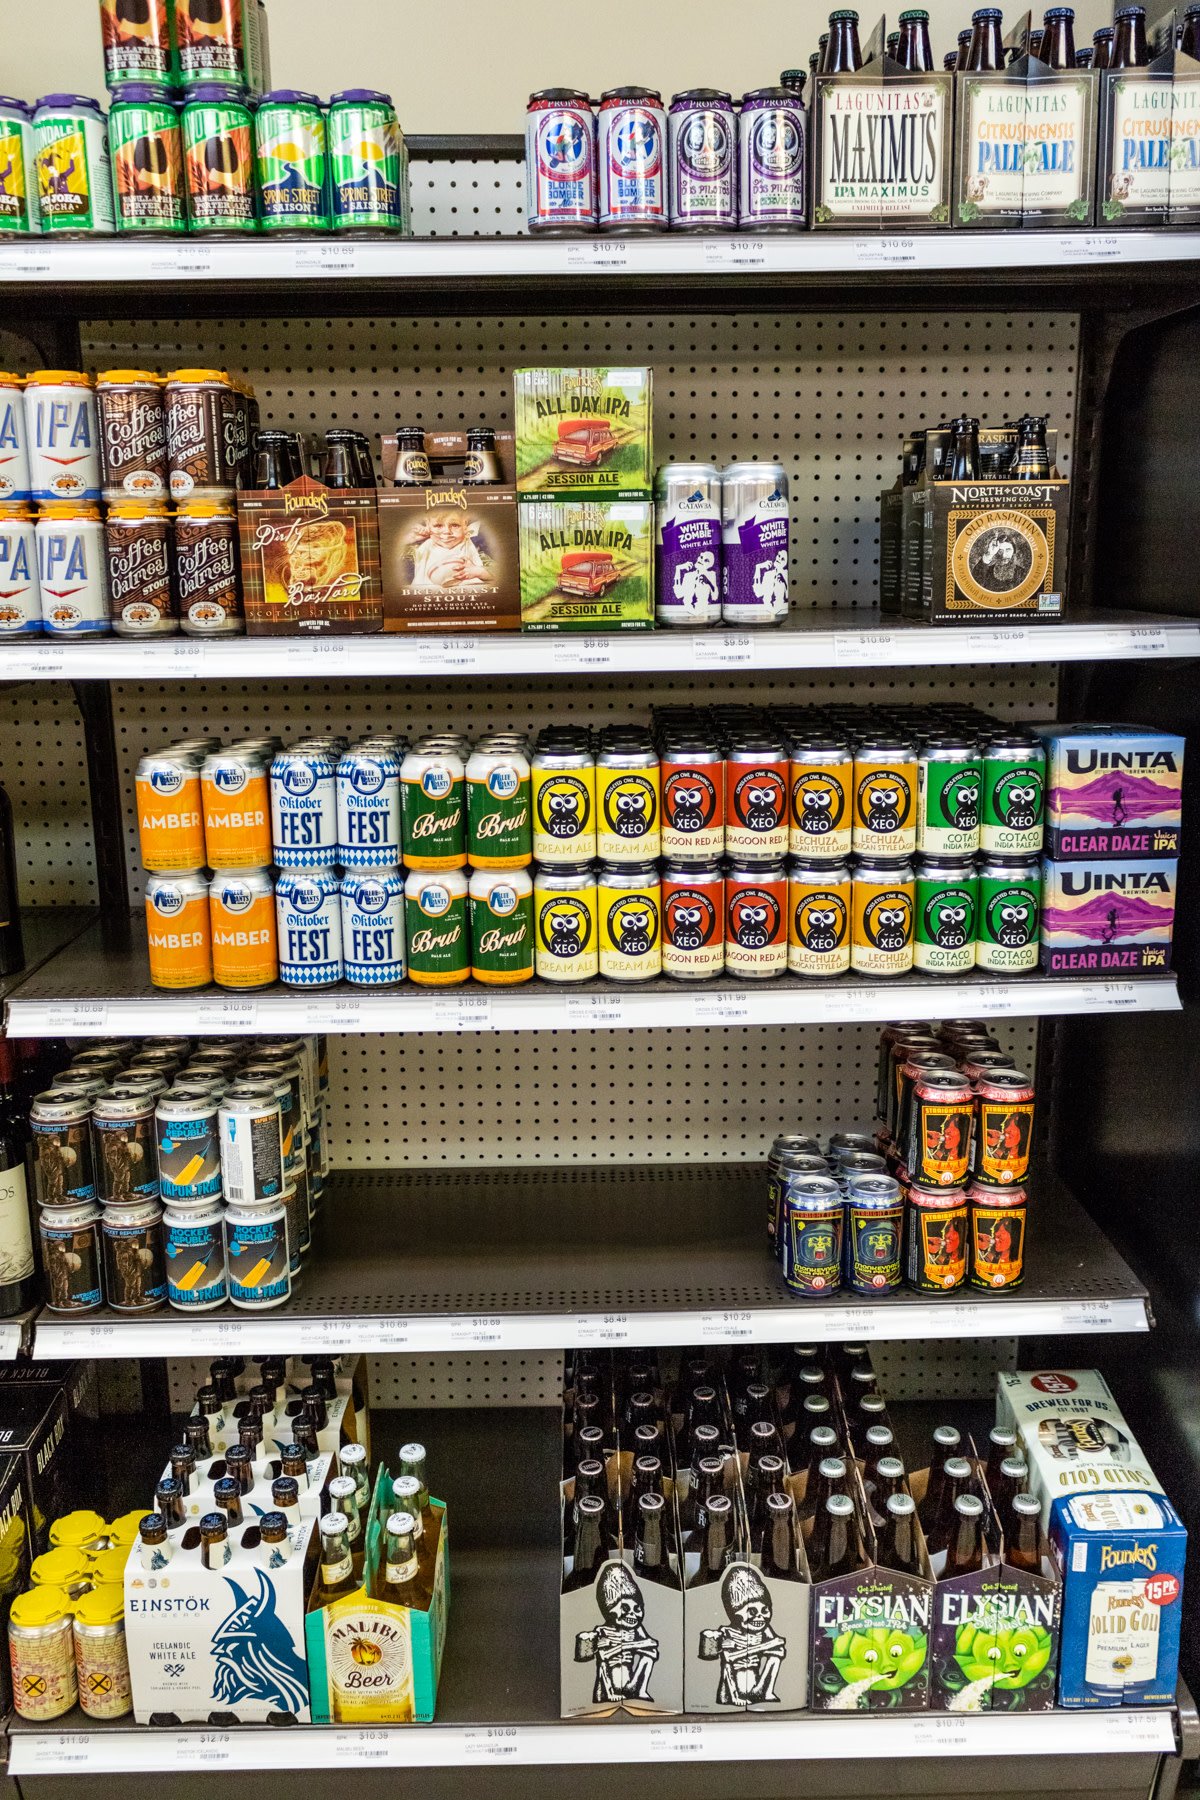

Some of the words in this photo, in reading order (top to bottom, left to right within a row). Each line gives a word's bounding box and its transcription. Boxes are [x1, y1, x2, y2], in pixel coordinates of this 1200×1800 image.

[548, 100, 579, 108] PROPS
[690, 100, 720, 108] PROPS
[836, 93, 920, 110] LAGUNITAS
[988, 94, 1067, 113] LAGUNITAS
[829, 110, 937, 184] MAXIMUS
[1122, 138, 1169, 171] PALE
[977, 141, 1024, 174] PALE
[1036, 140, 1075, 174] ALE
[263, 189, 290, 205] SPRING
[292, 188, 320, 204] STREET
[340, 187, 368, 202] SPRING
[371, 188, 397, 202] STREET
[834, 186, 855, 198] IPA
[859, 185, 929, 198] MAXIMUS
[272, 203, 312, 213] SAISON
[350, 201, 388, 211] SAISON
[593, 243, 626, 252] $10.79
[731, 242, 763, 250] $10.79
[881, 240, 913, 248] $10.69
[535, 396, 567, 419] ALL
[571, 395, 600, 413] DAY
[606, 396, 631, 418] IPA
[36, 401, 91, 449] IPA
[107, 404, 162, 445] Coffee
[547, 472, 595, 485] SESSION
[598, 472, 619, 484] ALE
[425, 487, 468, 511] Founders
[951, 486, 1003, 503] NORTH
[1012, 486, 1056, 502] COAST
[285, 491, 328, 515] Founders
[678, 501, 712, 511] CATAWBA
[680, 521, 709, 533] WHITE
[760, 521, 785, 533] WHITE
[965, 519, 984, 537] OLD
[987, 512, 1038, 535] RASPUTIN
[252, 513, 329, 554] Dirty
[539, 530, 570, 552] ALL
[574, 529, 603, 547] DAY
[607, 530, 632, 551] IPA
[678, 530, 713, 543] ZOMBIE
[759, 529, 787, 542] ZOMBIE
[680, 541, 701, 550] WHITE
[702, 539, 713, 548] ALE
[110, 537, 162, 578] Coffee
[178, 536, 228, 577] Coffee
[112, 540, 169, 600] Oatmeal
[180, 540, 235, 598] Oatmeal
[142, 575, 170, 596] STOUT
[284, 572, 372, 608] Bastard
[402, 586, 499, 597] BREAKFAST
[424, 594, 478, 603] STOUT
[249, 609, 300, 618] SCOTCH
[309, 608, 348, 617] STYLE
[357, 606, 380, 615] ALE
[724, 638, 749, 646] $9.59
[1065, 749, 1178, 775] UINTA
[280, 796, 322, 811] Oktober
[347, 795, 390, 811] Oktober
[142, 812, 200, 829] AMBER
[207, 812, 265, 828] AMBER
[348, 811, 390, 844] FEST
[412, 808, 460, 839] Brut
[477, 808, 527, 839] Brut
[676, 818, 700, 829] XEO
[750, 817, 774, 829] XEO
[281, 812, 322, 844] FEST
[552, 824, 577, 835] XEO
[619, 823, 644, 835] XEO
[695, 836, 711, 846] RED
[795, 835, 839, 846] LECHUZA
[861, 834, 905, 845] LECHUZA
[999, 832, 1039, 843] COTACO
[1061, 836, 1109, 853] CLEAR
[1112, 835, 1149, 852] DAZE
[1154, 830, 1178, 843] Juicy
[538, 843, 574, 854] CREAM
[576, 842, 592, 853] ALE
[604, 842, 641, 854] CREAM
[1153, 839, 1177, 850] IPA
[1060, 871, 1171, 896] UINTA
[287, 914, 329, 928] Oktober
[149, 932, 203, 949] AMBER
[214, 930, 270, 946] AMBER
[288, 929, 330, 960] FEST
[352, 929, 394, 960] FEST
[411, 924, 461, 954] Brut
[479, 924, 527, 953] Brut
[800, 953, 842, 963] LECHUZA
[929, 950, 970, 960] COTACO
[991, 949, 1032, 960] COTACO
[1052, 953, 1099, 970] CLEAR
[1102, 952, 1138, 968] DAZE
[885, 961, 904, 970] STYLE
[925, 958, 945, 966] INDIA
[946, 959, 962, 967] PALE
[166, 1127, 209, 1137] REPUBLIC
[168, 1119, 207, 1130] ROCKET
[171, 1227, 209, 1237] ROCKET
[236, 1224, 274, 1234] ROCKET
[169, 1234, 212, 1243] REPUBLIC
[1026, 1399, 1070, 1412] BREWED
[1071, 1399, 1091, 1407] FOR
[37, 1432, 54, 1474] BLACK
[1060, 1469, 1100, 1486] GOLD
[1104, 1469, 1150, 1486] SOLID
[1100, 1541, 1157, 1571] Founders
[1147, 1582, 1162, 1599] 15
[1163, 1580, 1176, 1596] PK
[130, 1595, 210, 1612] EINSTÖK
[819, 1594, 929, 1628] ELYSIAN
[942, 1593, 1054, 1626] ELYSIAN
[841, 1620, 862, 1632] Space
[866, 1619, 885, 1630] Dust
[1092, 1615, 1126, 1636] SOLID
[1130, 1609, 1158, 1632] GOLD
[332, 1621, 402, 1643] MALIBU
[153, 1642, 191, 1650] ICELANDIC
[1097, 1643, 1128, 1652] PREMIUM
[149, 1652, 177, 1660] WHITE
[180, 1651, 196, 1660] ALE
[344, 1671, 393, 1688] Beer
